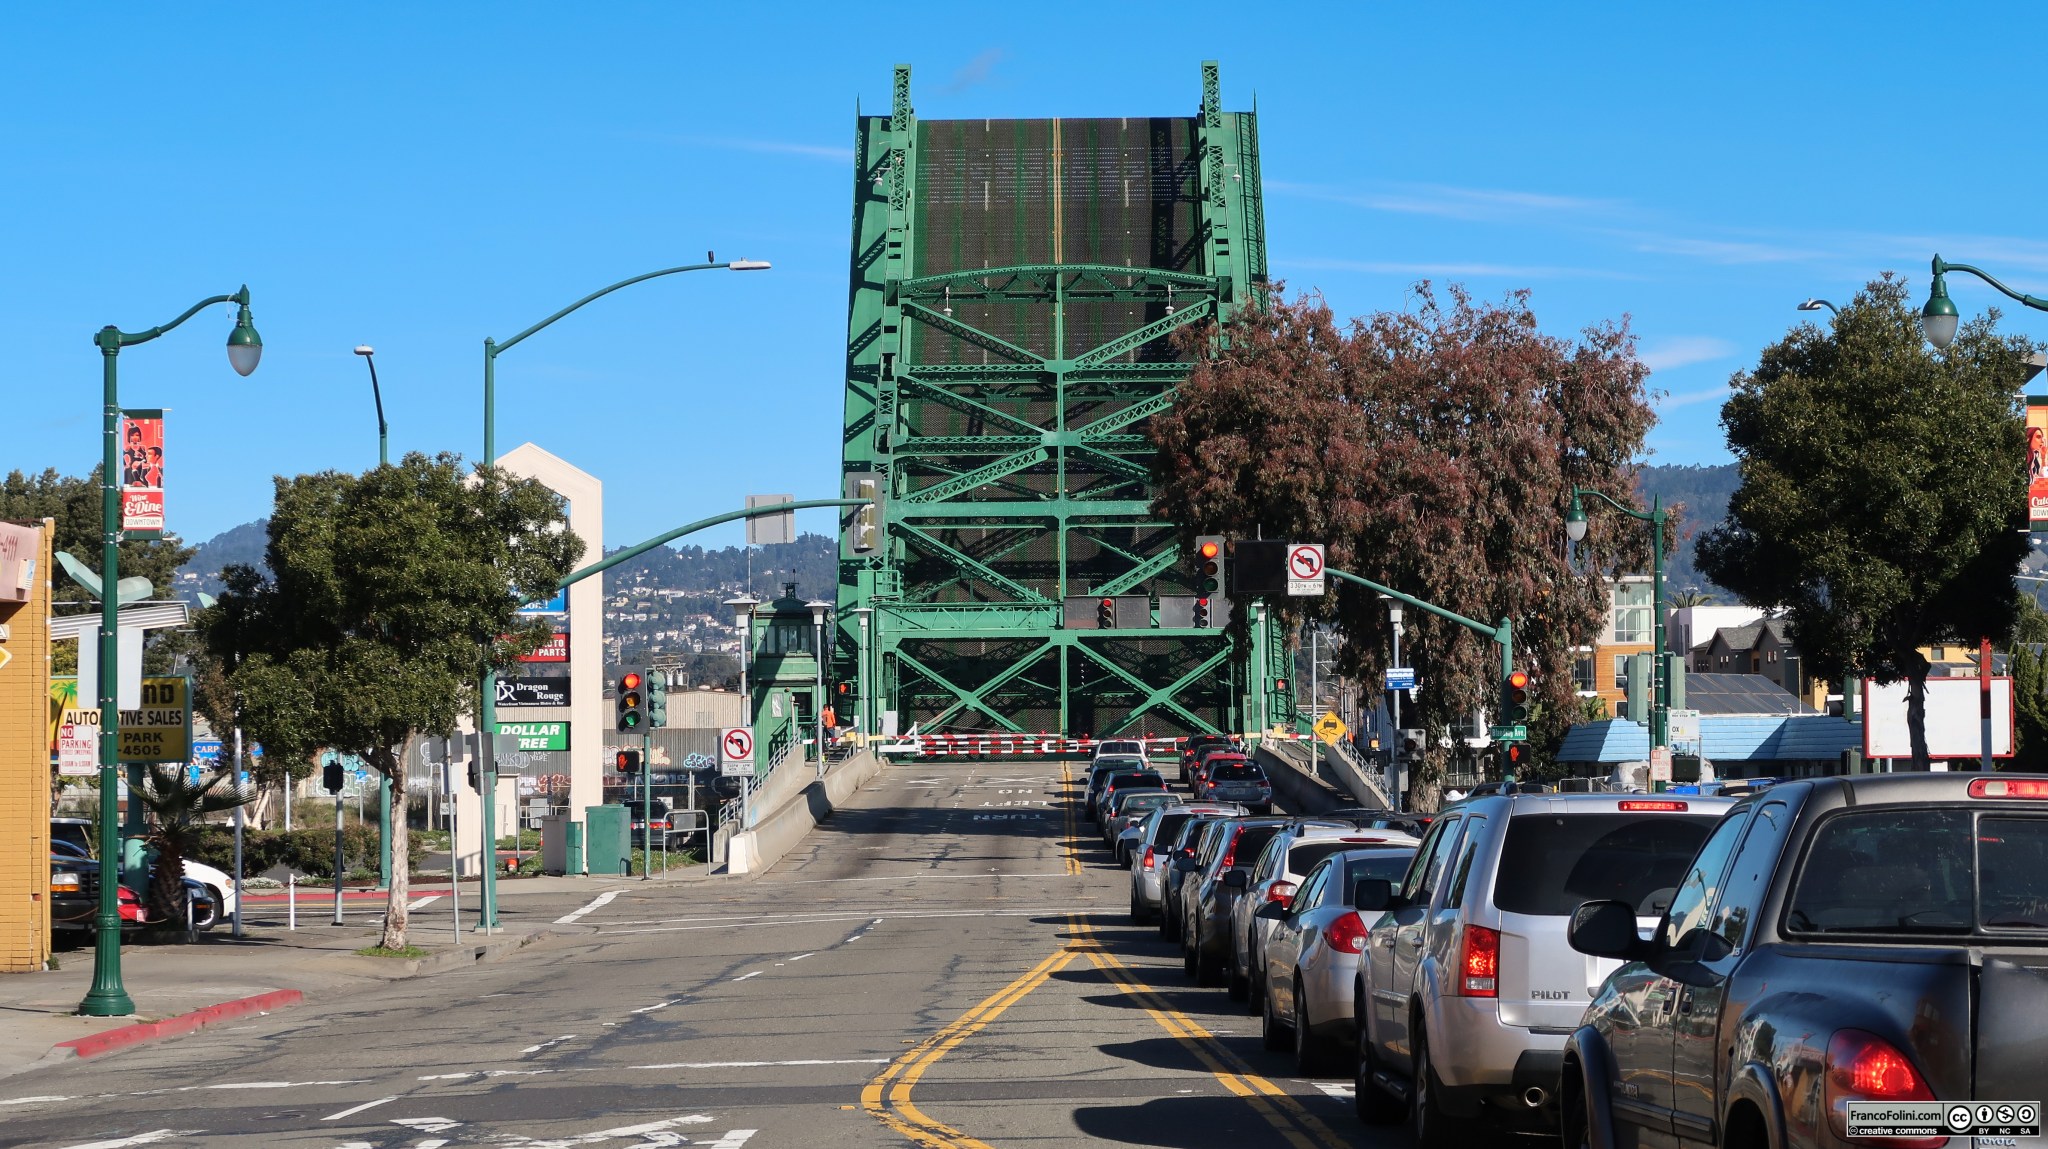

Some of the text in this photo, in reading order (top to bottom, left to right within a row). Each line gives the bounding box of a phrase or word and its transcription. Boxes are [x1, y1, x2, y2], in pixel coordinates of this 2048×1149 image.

[125, 518, 161, 526] DOWNTOWN
[544, 639, 564, 648] UTO
[538, 648, 566, 657] PARTS
[516, 682, 549, 693] Dragon
[536, 691, 564, 702] Rouge
[65, 709, 182, 726] AUTOTIVE SALES
[61, 727, 74, 738] NO
[500, 724, 560, 736] DOLLAR
[123, 732, 164, 743] PARK
[61, 739, 92, 749] PARKING
[194, 745, 220, 754] CARP
[117, 745, 161, 756] -4505
[1531, 990, 1571, 1000] PILOT
[1977, 1136, 2017, 1147] TOYOTA
